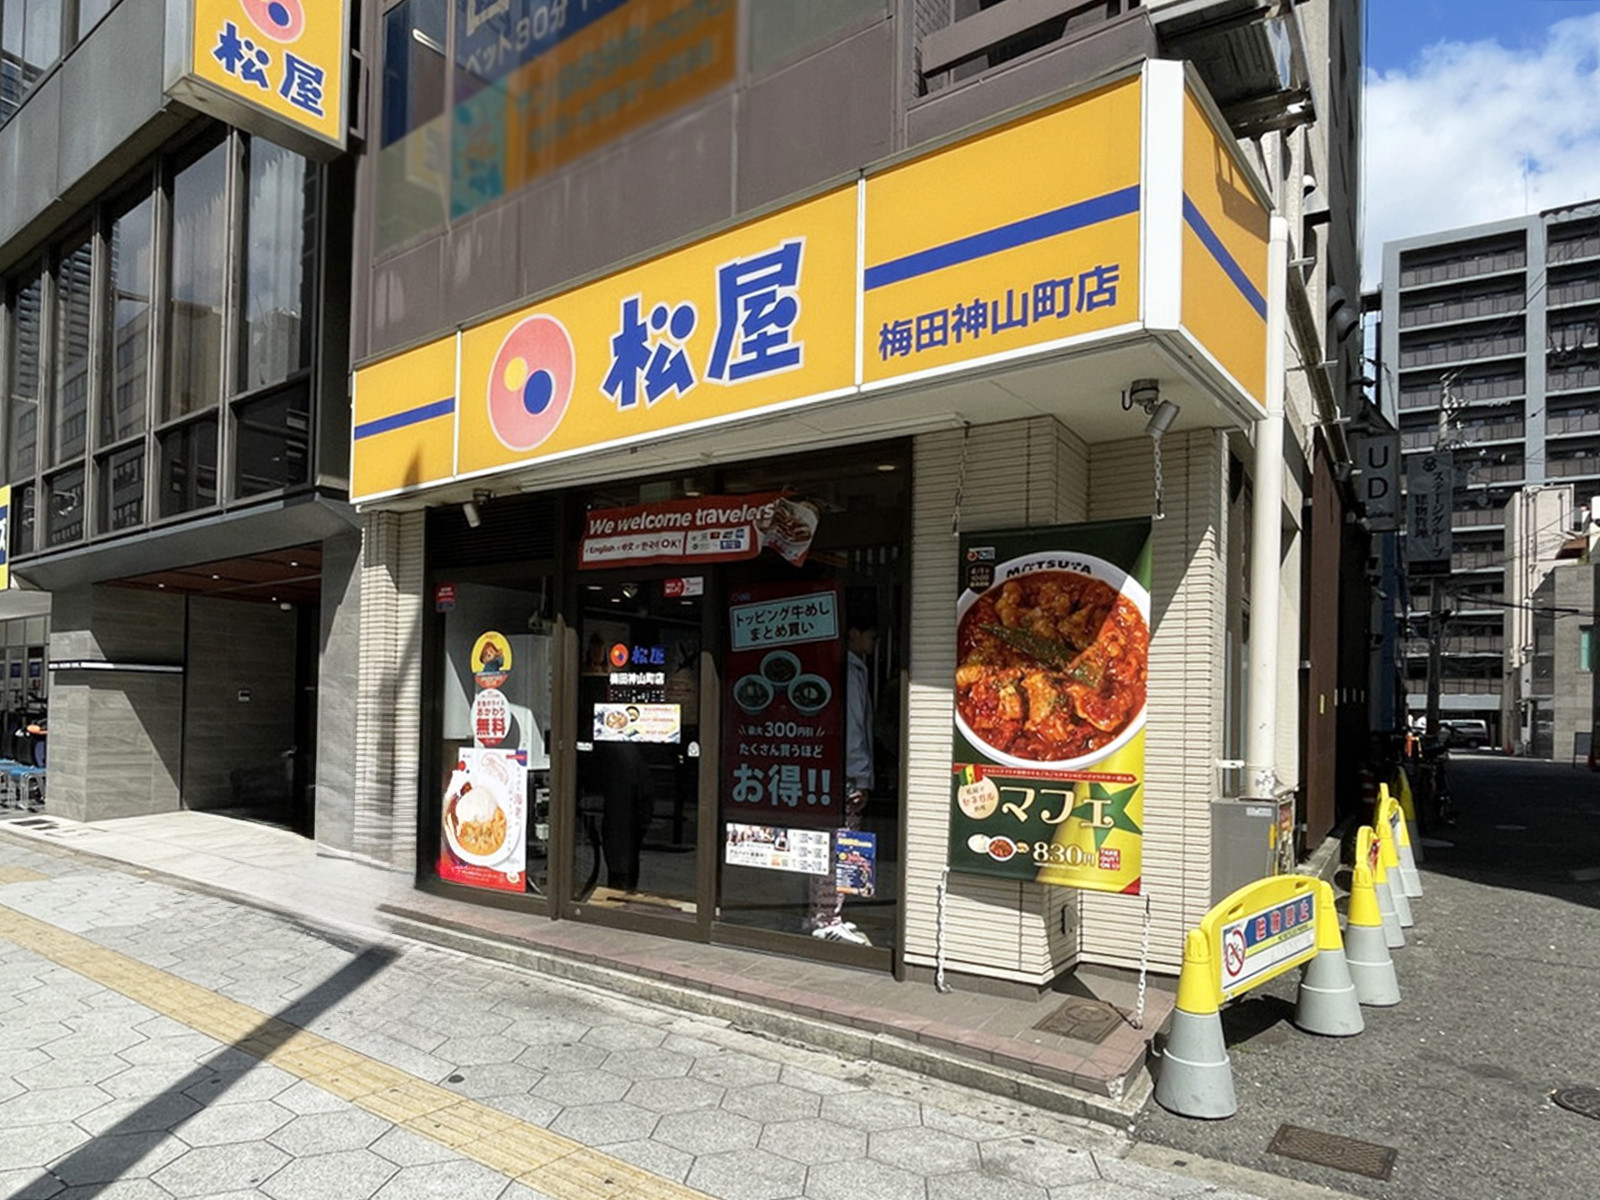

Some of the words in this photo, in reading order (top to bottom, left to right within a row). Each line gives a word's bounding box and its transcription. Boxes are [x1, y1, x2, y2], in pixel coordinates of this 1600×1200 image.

[212, 20, 327, 118] 松屋
[600, 238, 805, 410] 松屋
[879, 264, 1120, 361] 梅田神山町店
[588, 518, 614, 536] We
[617, 510, 692, 531] welcome
[736, 601, 830, 628] トッピング牛めし
[750, 622, 815, 642] まとめ買い
[477, 708, 506, 717] おかわり
[476, 717, 506, 736] 無料
[739, 742, 824, 758] たくさん買うほど
[732, 763, 831, 807] お得!!
[1033, 841, 1096, 867] 830円
